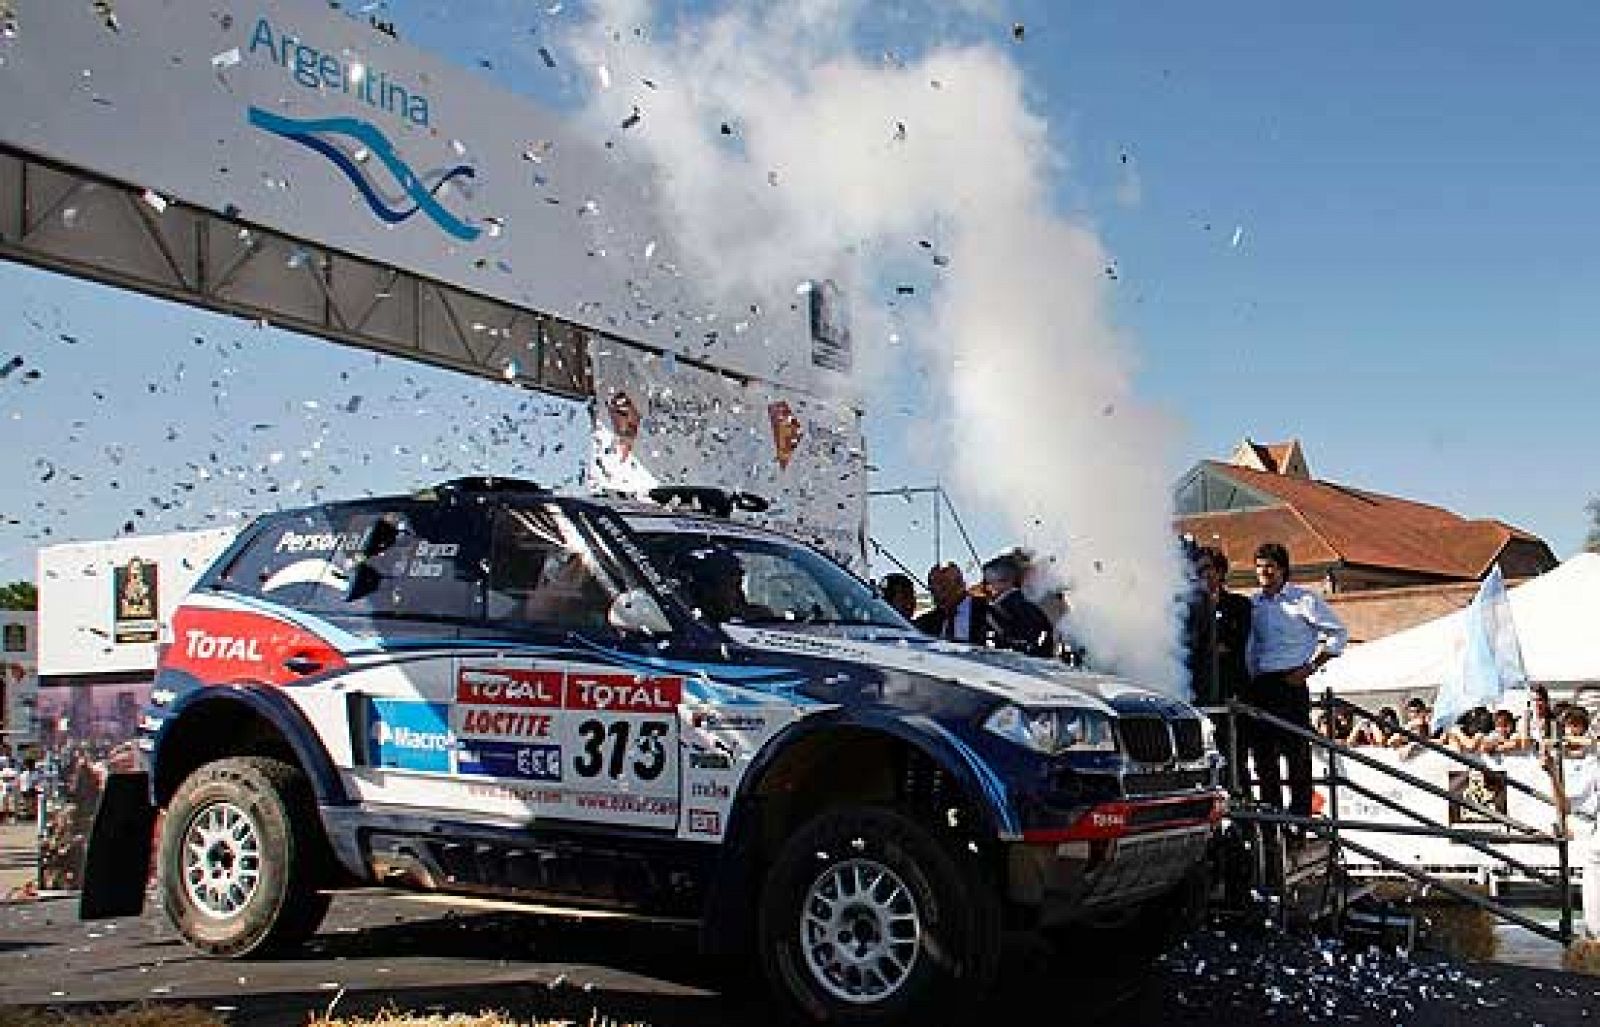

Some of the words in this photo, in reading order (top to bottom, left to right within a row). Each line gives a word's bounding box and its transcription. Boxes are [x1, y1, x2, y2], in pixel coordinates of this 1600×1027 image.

[249, 17, 429, 128] Argentina
[185, 630, 263, 662] TOTAL
[575, 680, 672, 707] TOTAL
[462, 709, 551, 736] LOCTITE
